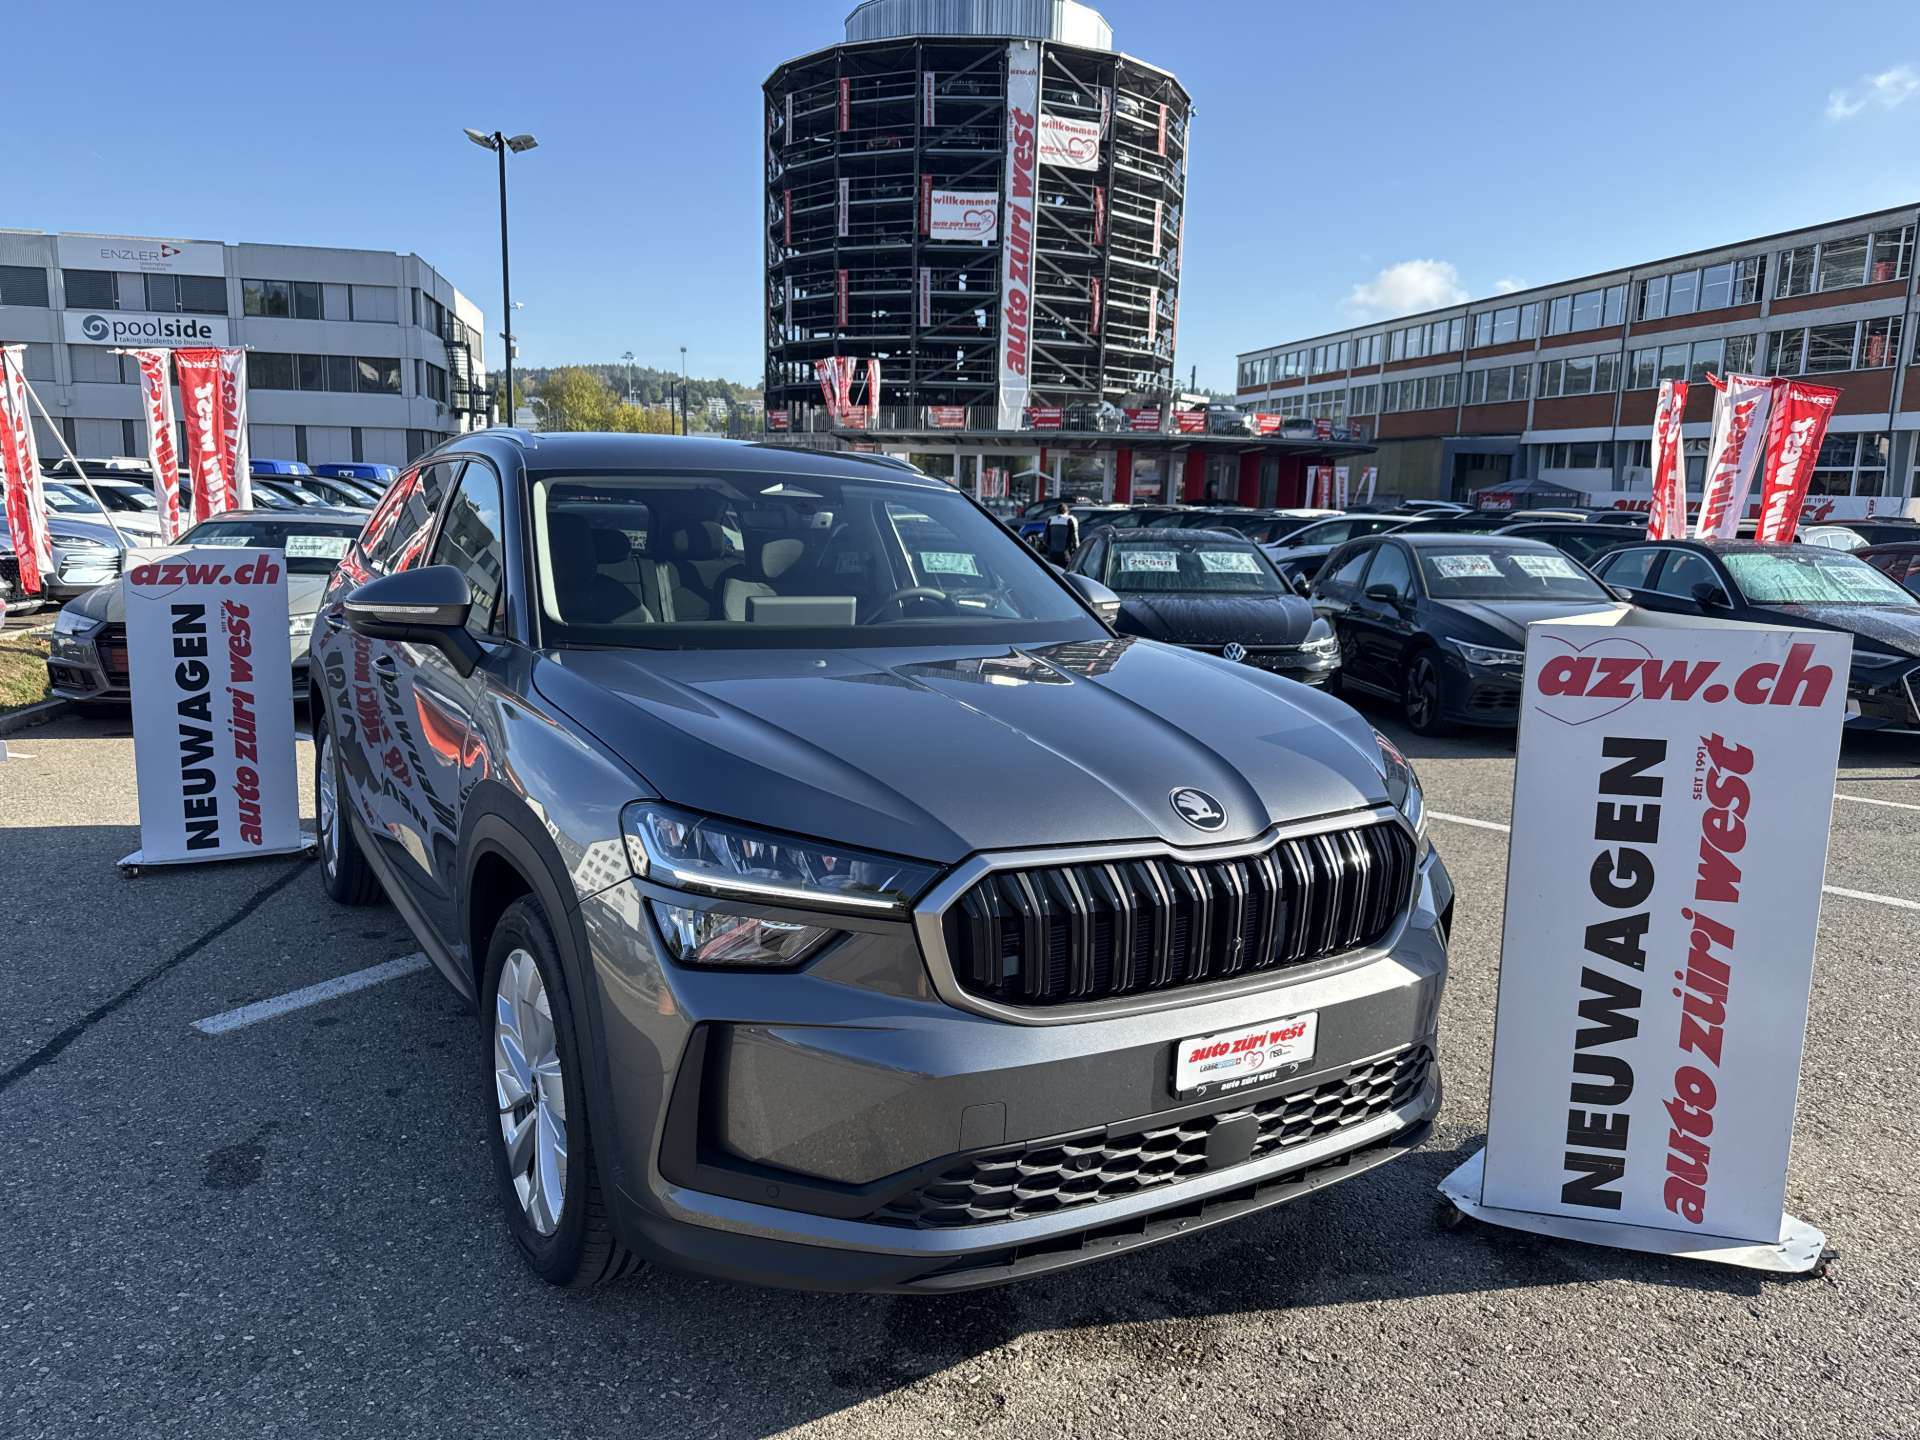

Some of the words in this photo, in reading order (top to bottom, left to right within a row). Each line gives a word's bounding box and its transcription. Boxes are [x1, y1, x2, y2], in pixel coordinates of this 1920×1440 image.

[1011, 106, 1035, 198] west
[1041, 120, 1098, 136] willkommen
[933, 195, 997, 206] willkommen
[100, 248, 160, 261] ENZLER
[1005, 201, 1033, 288] züri
[113, 317, 212, 342] poolside
[119, 336, 142, 345] taking
[143, 337, 174, 346] students
[175, 338, 182, 346] to
[183, 338, 214, 347] business
[1004, 288, 1028, 377] auto
[130, 554, 280, 585] azw.ch
[220, 599, 254, 682] west
[1537, 643, 1834, 708] azw.ch
[170, 603, 220, 850] NEUWAGEN
[226, 686, 258, 765] züri
[1695, 745, 1706, 773] 1991
[232, 765, 263, 846] auto
[1692, 777, 1703, 801] SEIT
[1694, 731, 1755, 904] west
[1560, 736, 1668, 1210] NEUWAGEN
[1672, 907, 1736, 1069] züri
[1188, 1041, 1231, 1064] auto
[1231, 1030, 1269, 1054] züri
[1269, 1022, 1307, 1045] west
[1220, 1081, 1240, 1092] auto
[1240, 1074, 1258, 1087] züri
[1258, 1070, 1278, 1083] west
[1661, 1065, 1718, 1225] auto
